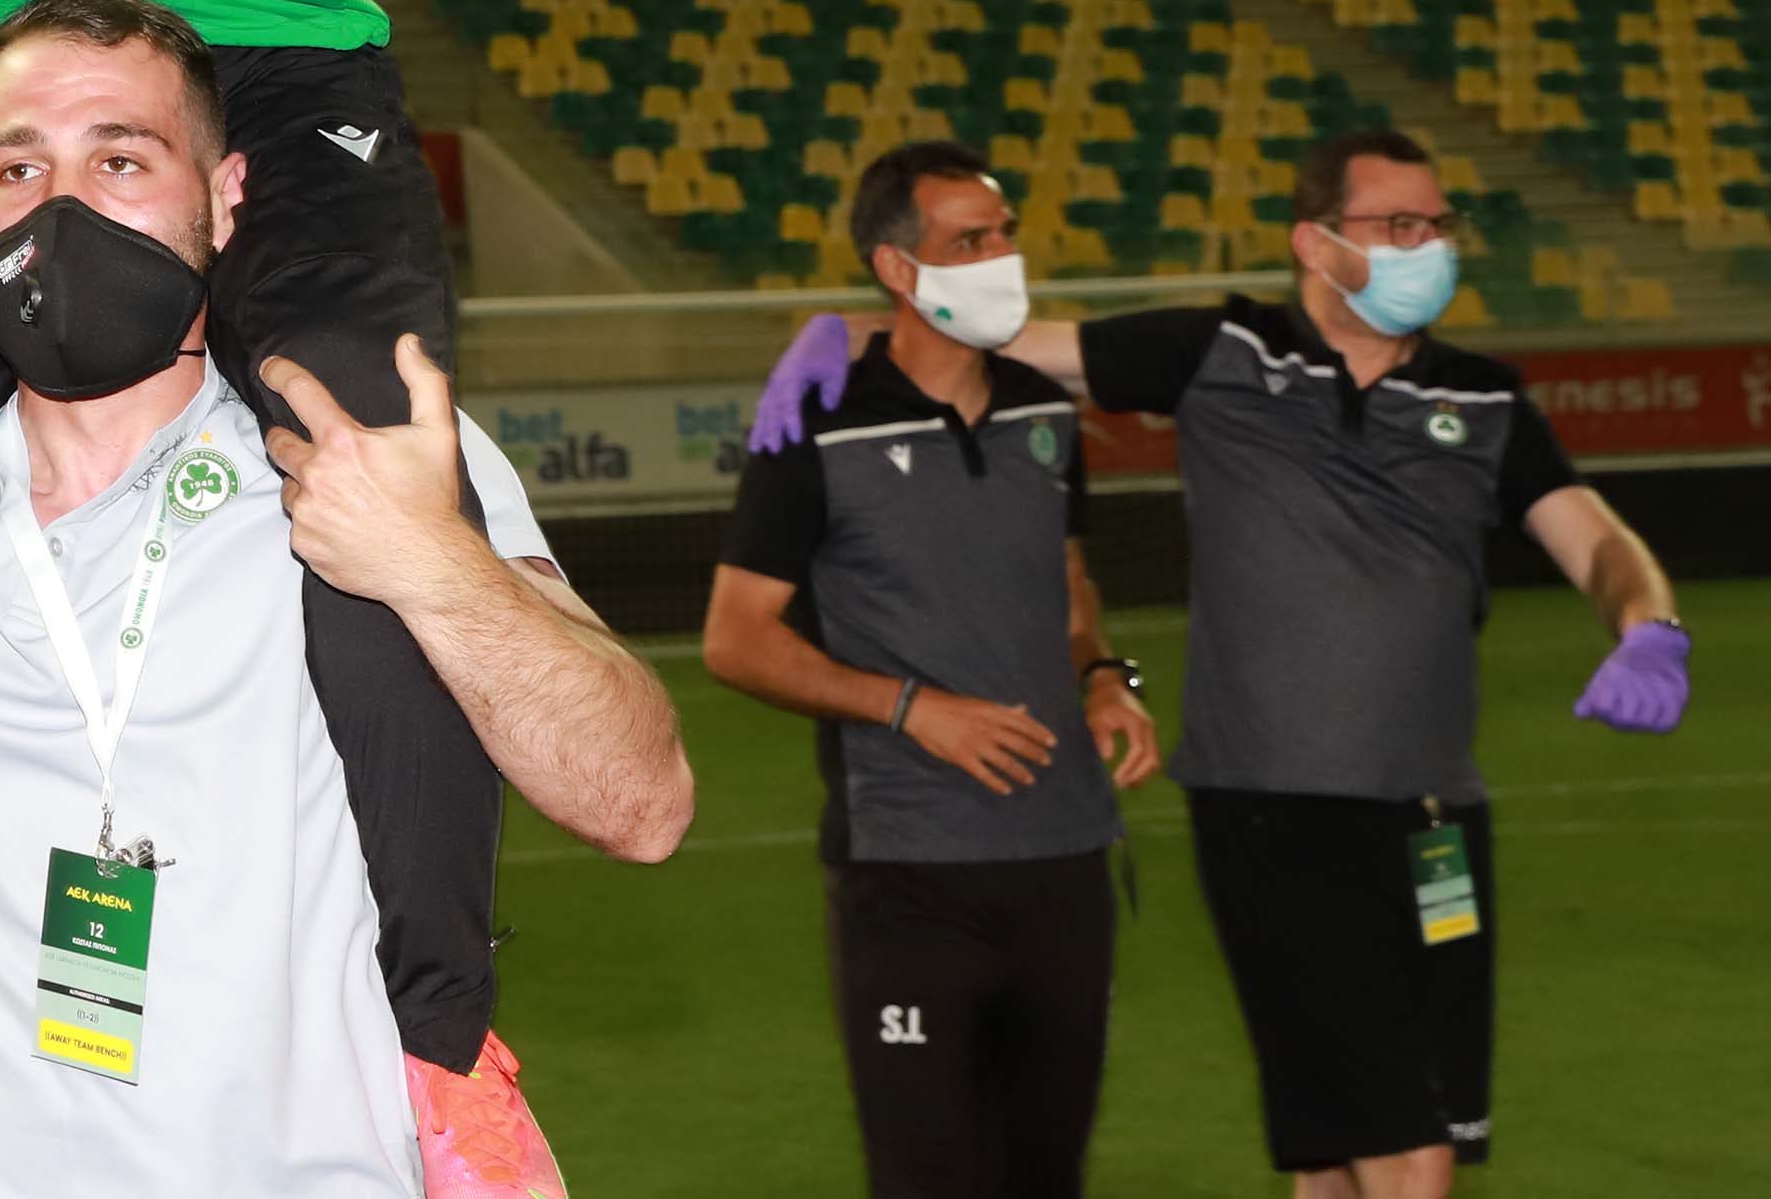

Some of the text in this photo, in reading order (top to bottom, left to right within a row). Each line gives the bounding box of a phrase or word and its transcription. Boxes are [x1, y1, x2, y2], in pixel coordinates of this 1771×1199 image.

[1527, 366, 1701, 414] enesis
[538, 431, 632, 484] alfa
[189, 479, 214, 490] 1948
[66, 886, 132, 912] AEK ARENA
[90, 921, 104, 939] 12
[73, 1039, 95, 1051] TEAM
